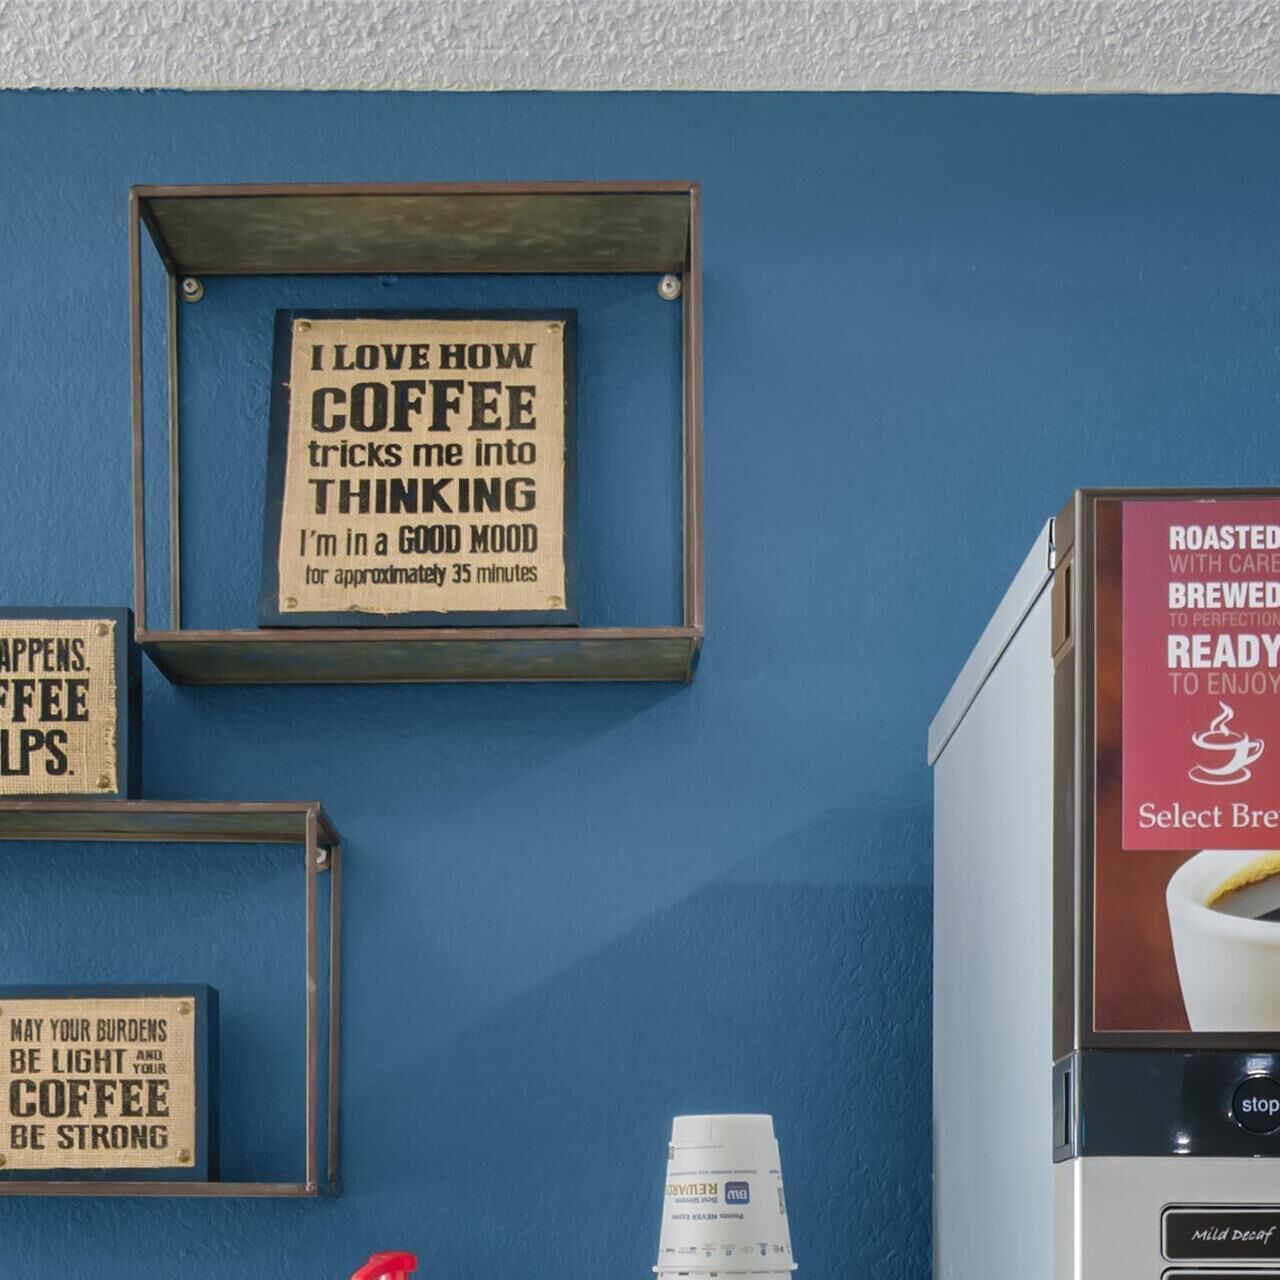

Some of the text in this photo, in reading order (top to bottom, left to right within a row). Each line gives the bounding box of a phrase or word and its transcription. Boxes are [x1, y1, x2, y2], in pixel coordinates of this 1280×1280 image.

[310, 342, 537, 371] I LOVE HOW
[311, 379, 537, 433] COFFEE
[308, 438, 537, 468] tricks me into
[308, 477, 537, 515] THINKING
[300, 524, 538, 557] I'm in a GOOD MOOD
[306, 563, 538, 589] for approximately 35 minutes
[1169, 553, 1223, 574] WITH
[1169, 612, 1189, 628] TO
[1168, 672, 1199, 696] TO
[1138, 802, 1223, 829] Select
[10, 1018, 168, 1043] MAY YOUR BURDENS
[10, 1048, 163, 1074] BE LIGHT AND
[132, 1062, 168, 1075] YOUR
[9, 1078, 170, 1118] COFFEE
[1241, 1096, 1280, 1116] stop
[10, 1124, 169, 1150] BE STRONG
[719, 1213, 744, 1221] Points
[1192, 1226, 1277, 1246] Mild Decaf
